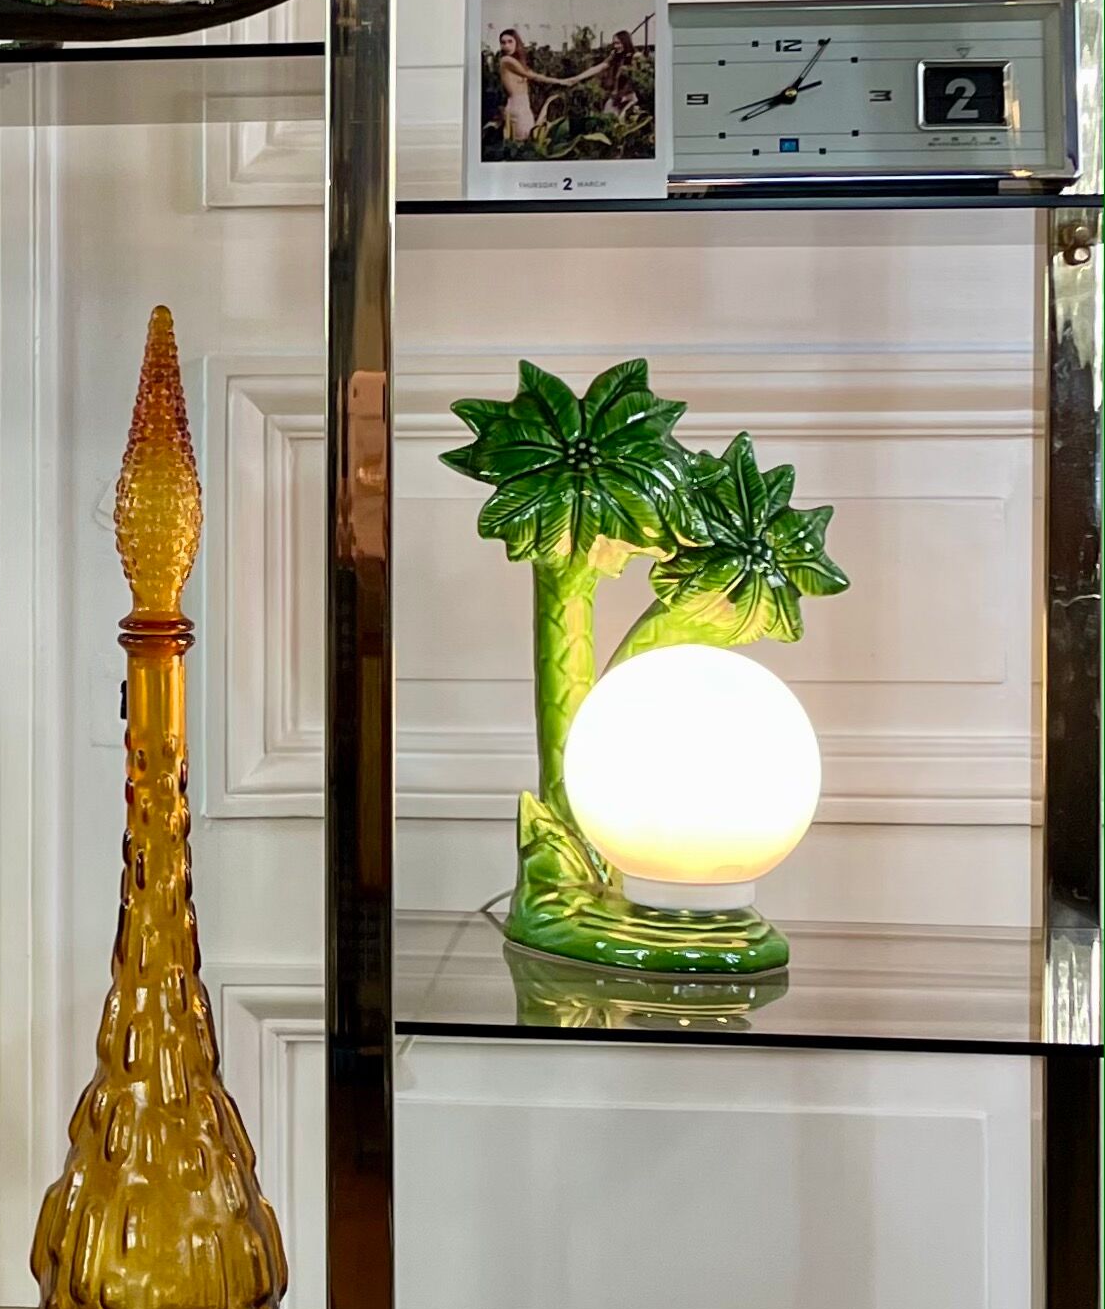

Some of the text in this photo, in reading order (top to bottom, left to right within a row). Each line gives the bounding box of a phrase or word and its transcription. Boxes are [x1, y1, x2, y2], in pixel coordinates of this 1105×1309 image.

[775, 39, 803, 52] 12
[944, 78, 979, 119] 2
[562, 177, 573, 190] 2
